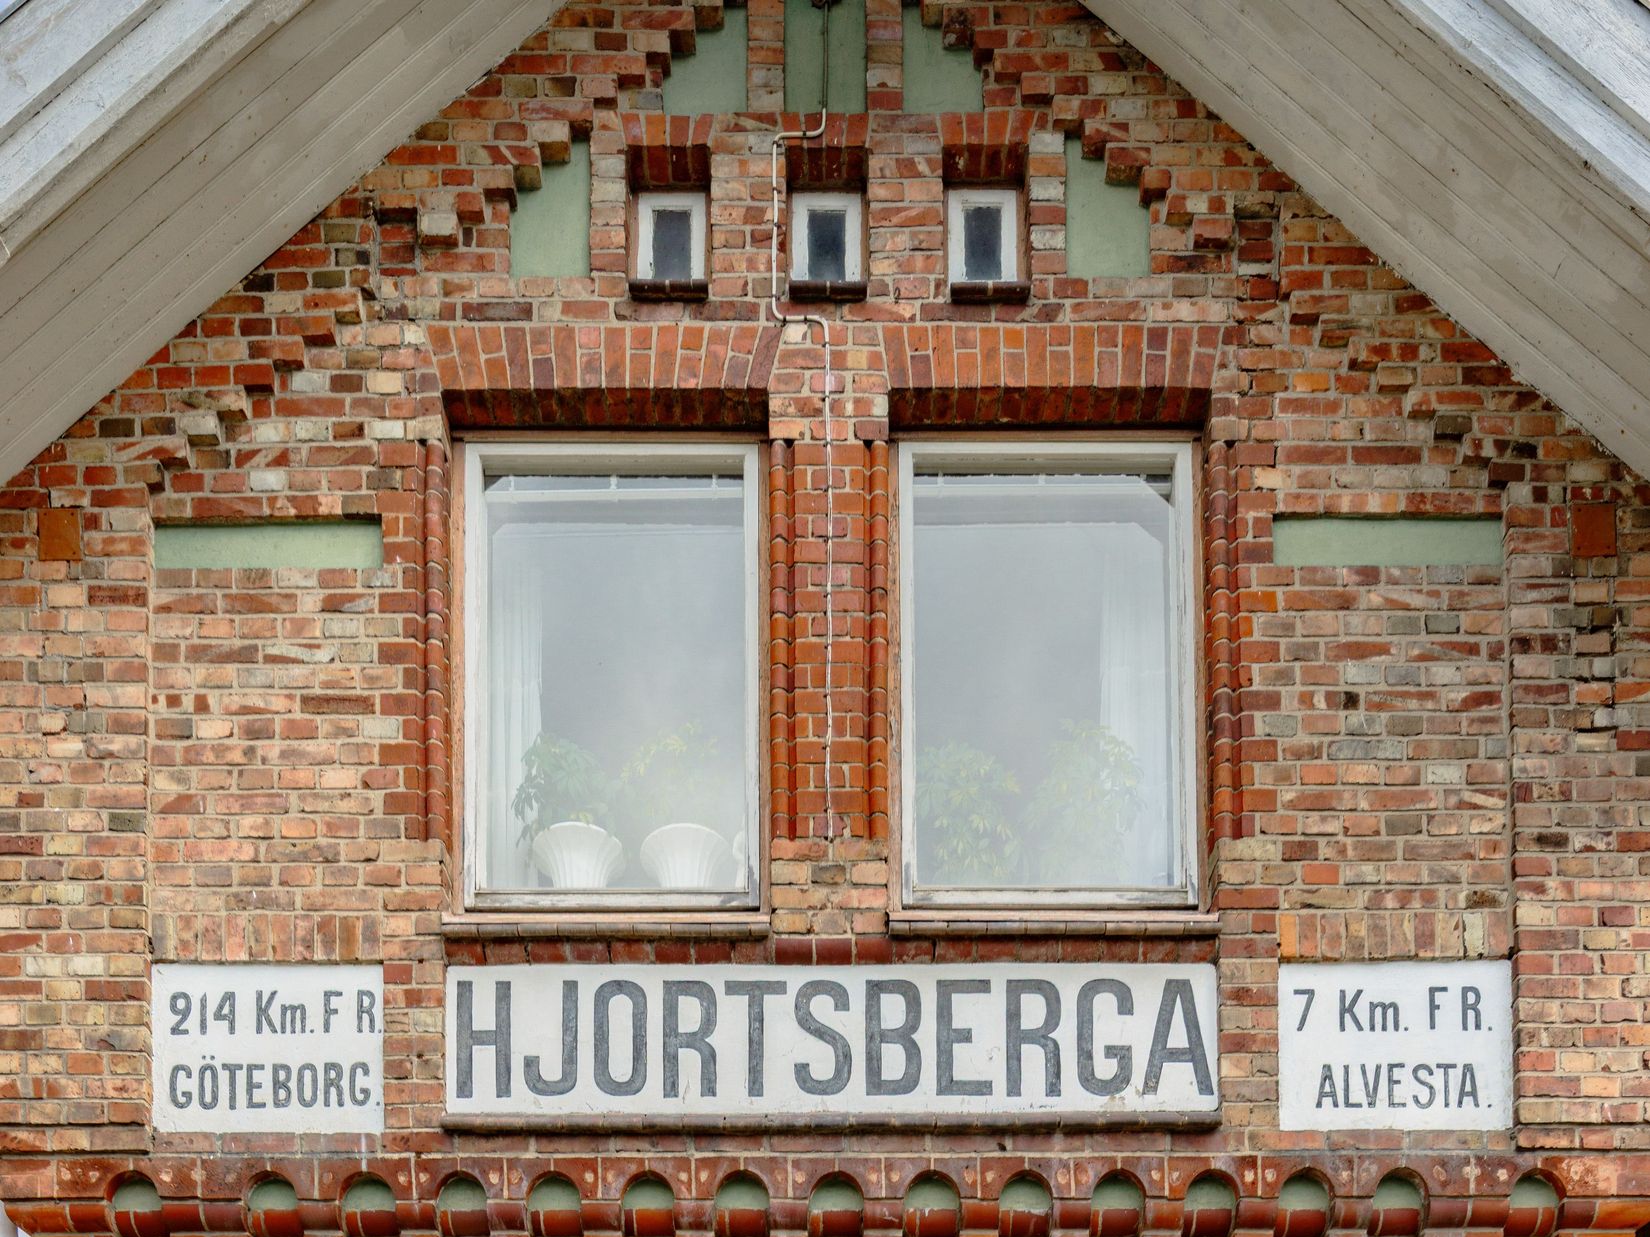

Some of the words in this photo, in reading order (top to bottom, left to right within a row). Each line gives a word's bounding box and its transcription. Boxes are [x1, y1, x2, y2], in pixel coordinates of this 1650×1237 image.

[169, 990, 237, 1036] 214
[255, 990, 315, 1034] Km.
[1293, 989, 1316, 1032] 7
[1338, 989, 1409, 1032] Km.
[455, 979, 1214, 1097] HJORTSBERGA
[169, 1054, 381, 1110] GÖTEBORG.
[1315, 1063, 1493, 1109] ALVESTA.
